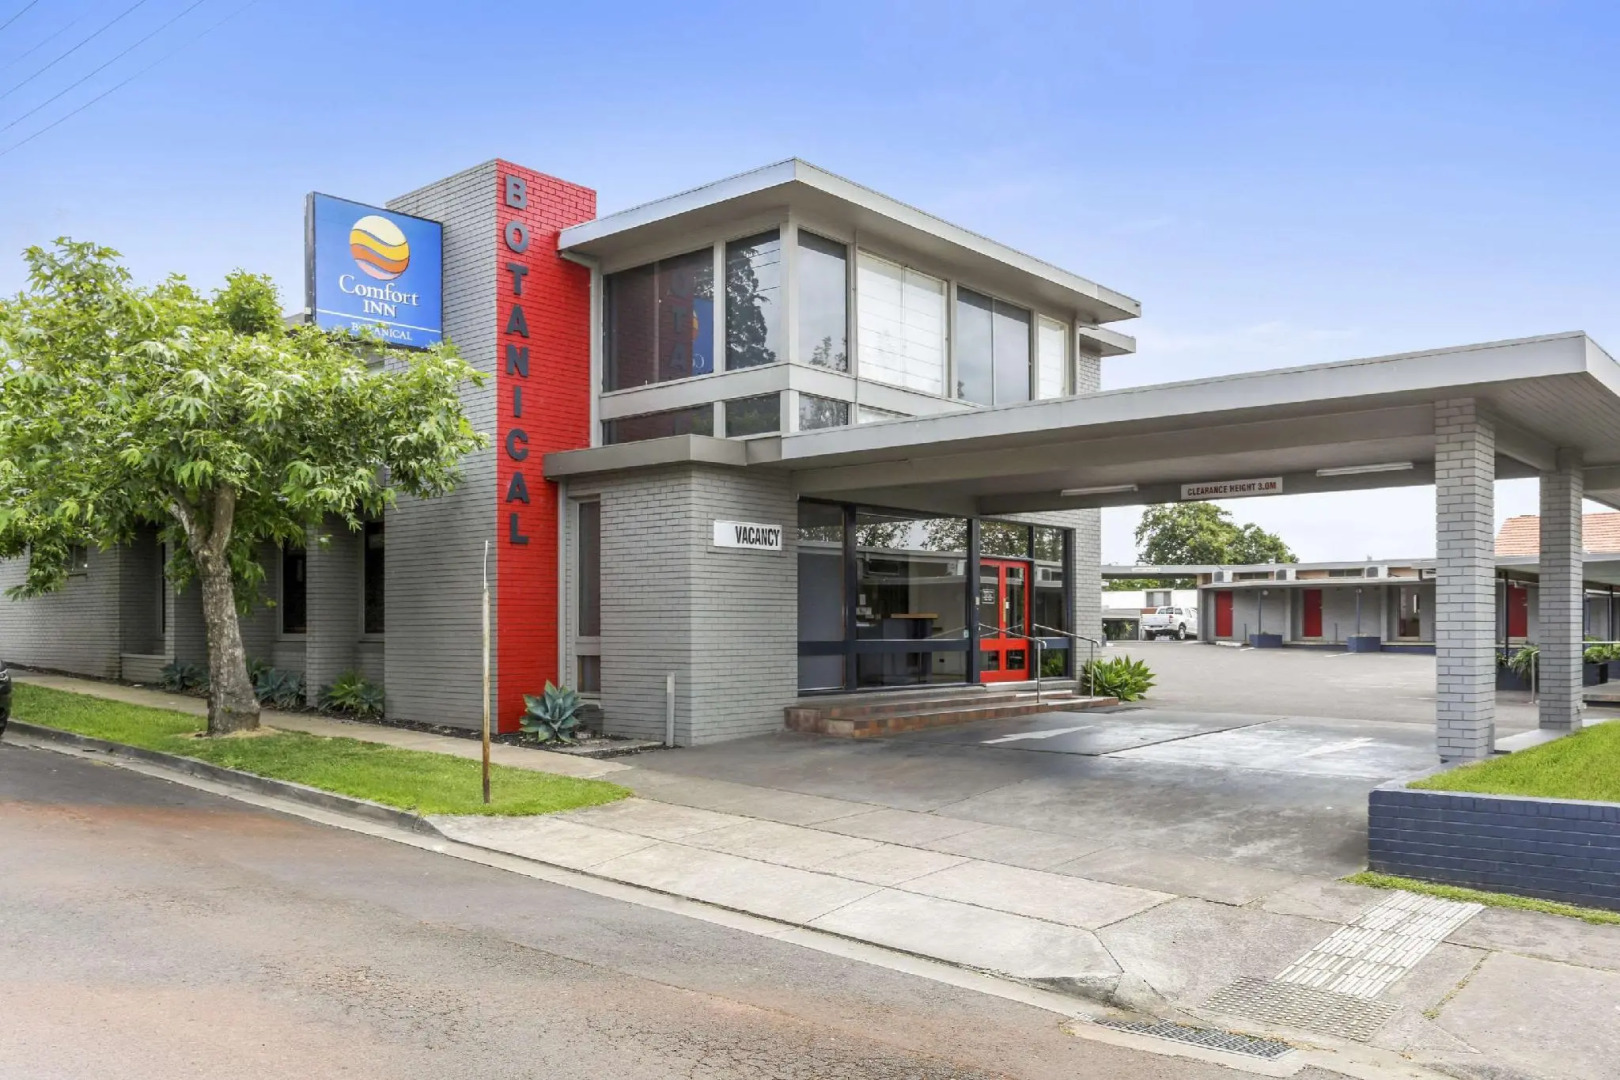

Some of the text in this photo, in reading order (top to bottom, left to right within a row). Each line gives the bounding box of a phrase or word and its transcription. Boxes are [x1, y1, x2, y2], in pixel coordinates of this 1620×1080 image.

[339, 274, 419, 306] Comfort
[363, 299, 397, 318] INN
[351, 322, 412, 340] BANICAL
[505, 174, 529, 544] BOTANICAL
[1187, 481, 1277, 496] CLEARANCE HEIGHT 3.0M
[735, 525, 780, 547] VACANCY
